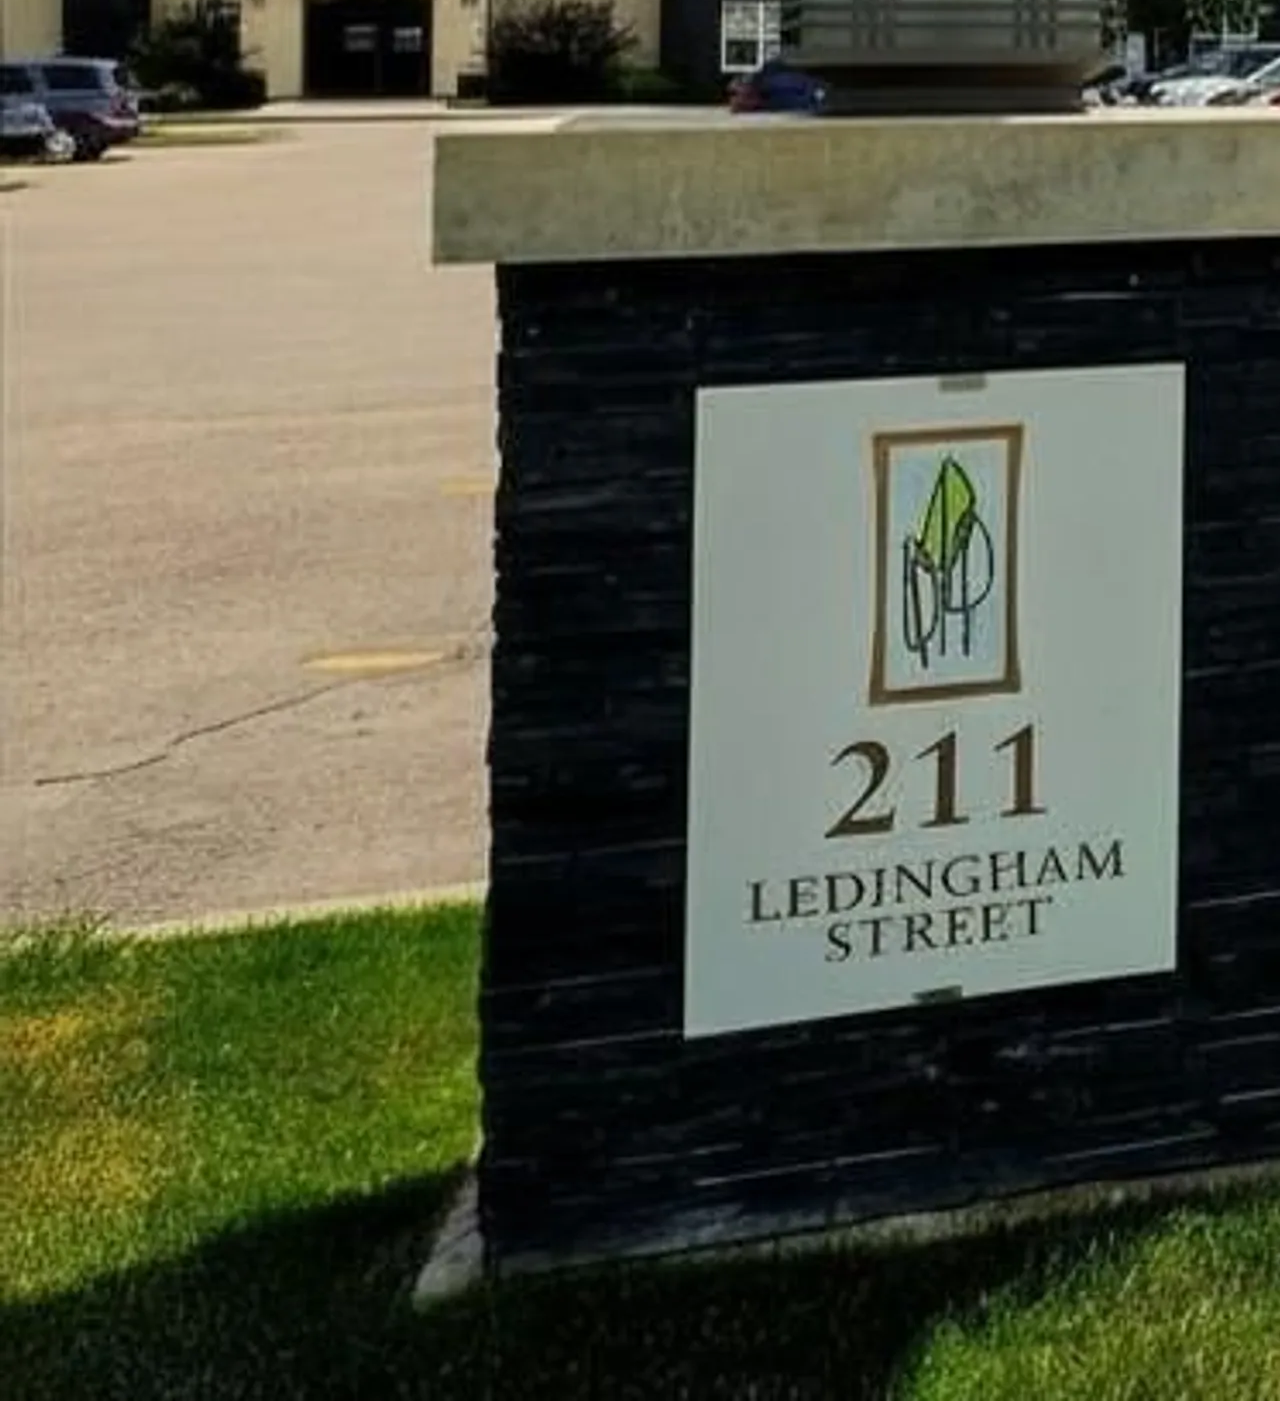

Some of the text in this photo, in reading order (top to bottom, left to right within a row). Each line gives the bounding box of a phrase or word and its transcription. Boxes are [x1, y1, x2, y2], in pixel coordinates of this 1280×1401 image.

[824, 723, 1048, 839] 211
[745, 839, 1126, 924] LEDINGHAM
[824, 896, 1054, 963] STREET
